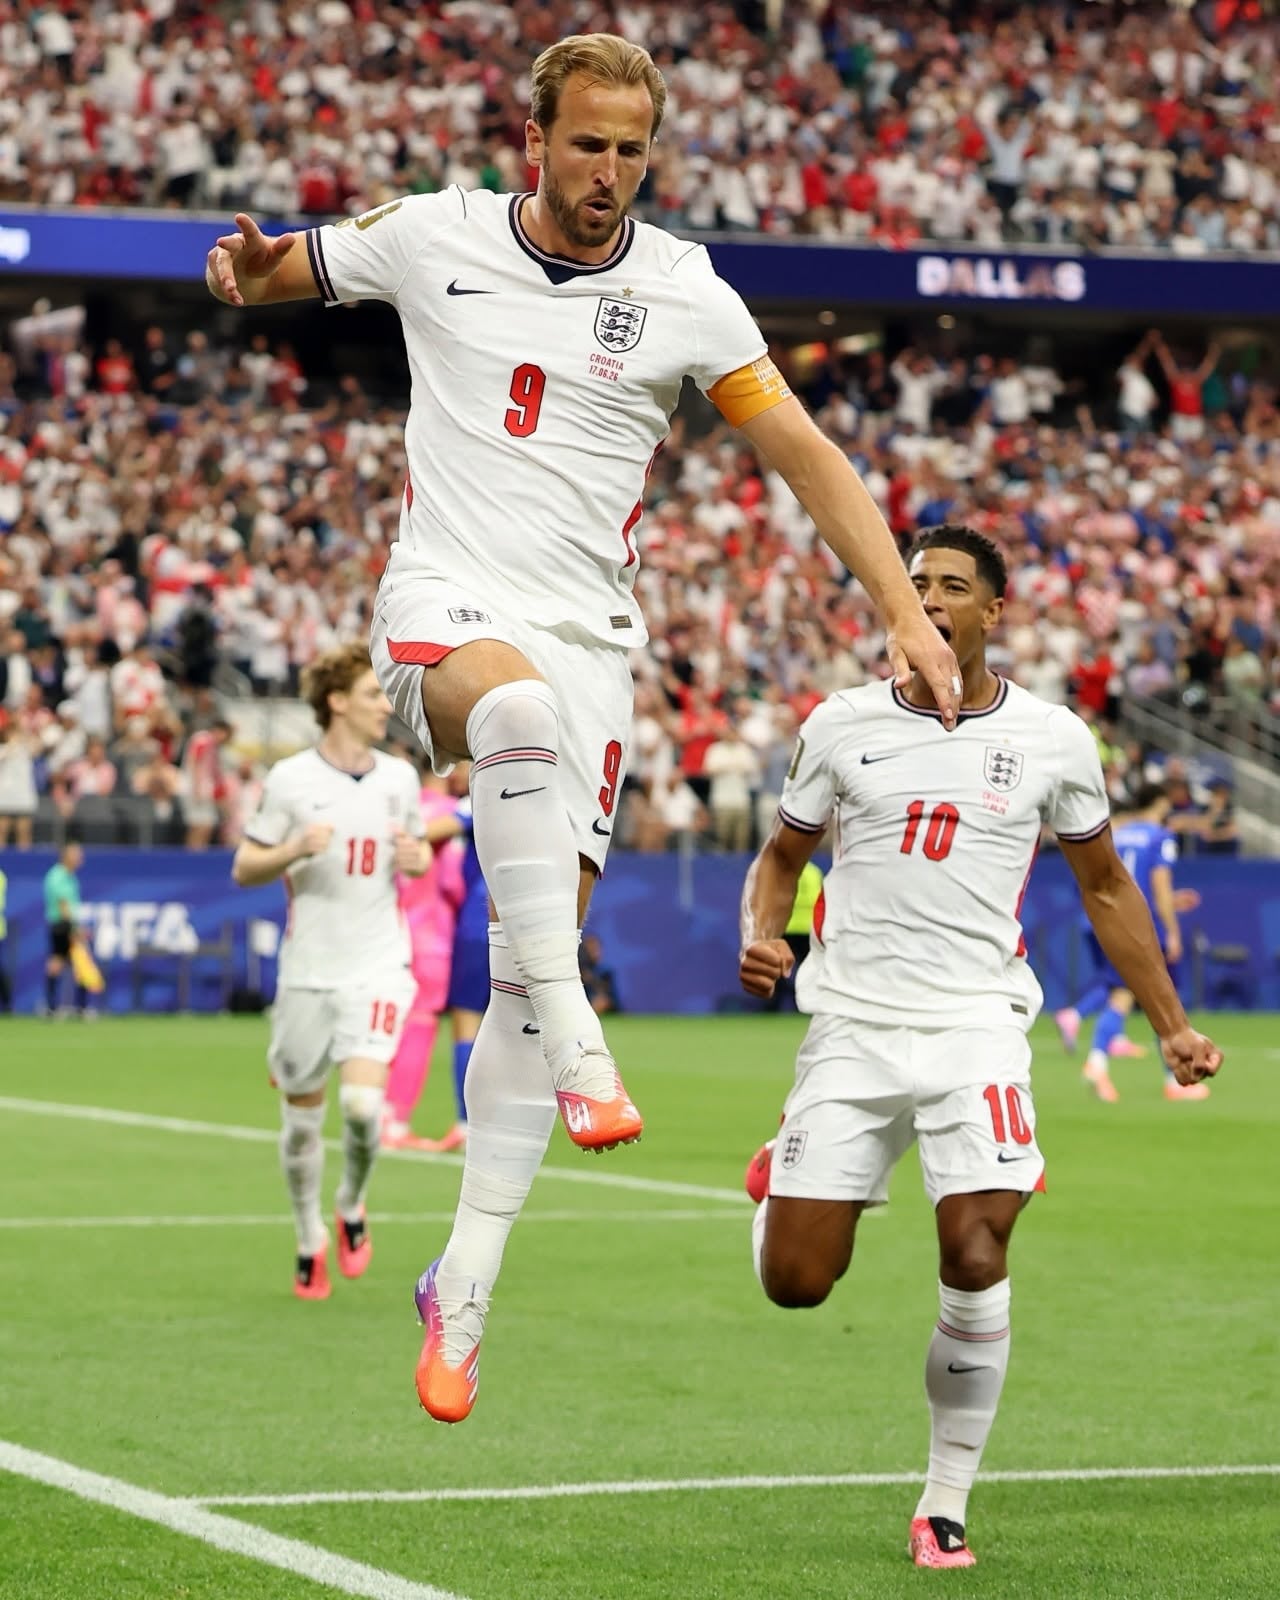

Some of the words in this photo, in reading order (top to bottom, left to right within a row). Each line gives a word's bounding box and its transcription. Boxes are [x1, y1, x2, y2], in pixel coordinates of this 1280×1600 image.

[917, 256, 1085, 301] DALLAS
[589, 364, 618, 382] 17.06.26
[590, 353, 624, 371] CROATIA
[504, 363, 546, 438] 9
[598, 739, 622, 817] 9
[900, 799, 960, 862] 10
[347, 837, 376, 876] 18
[371, 1000, 396, 1035] 18
[983, 1084, 1032, 1145] 10
